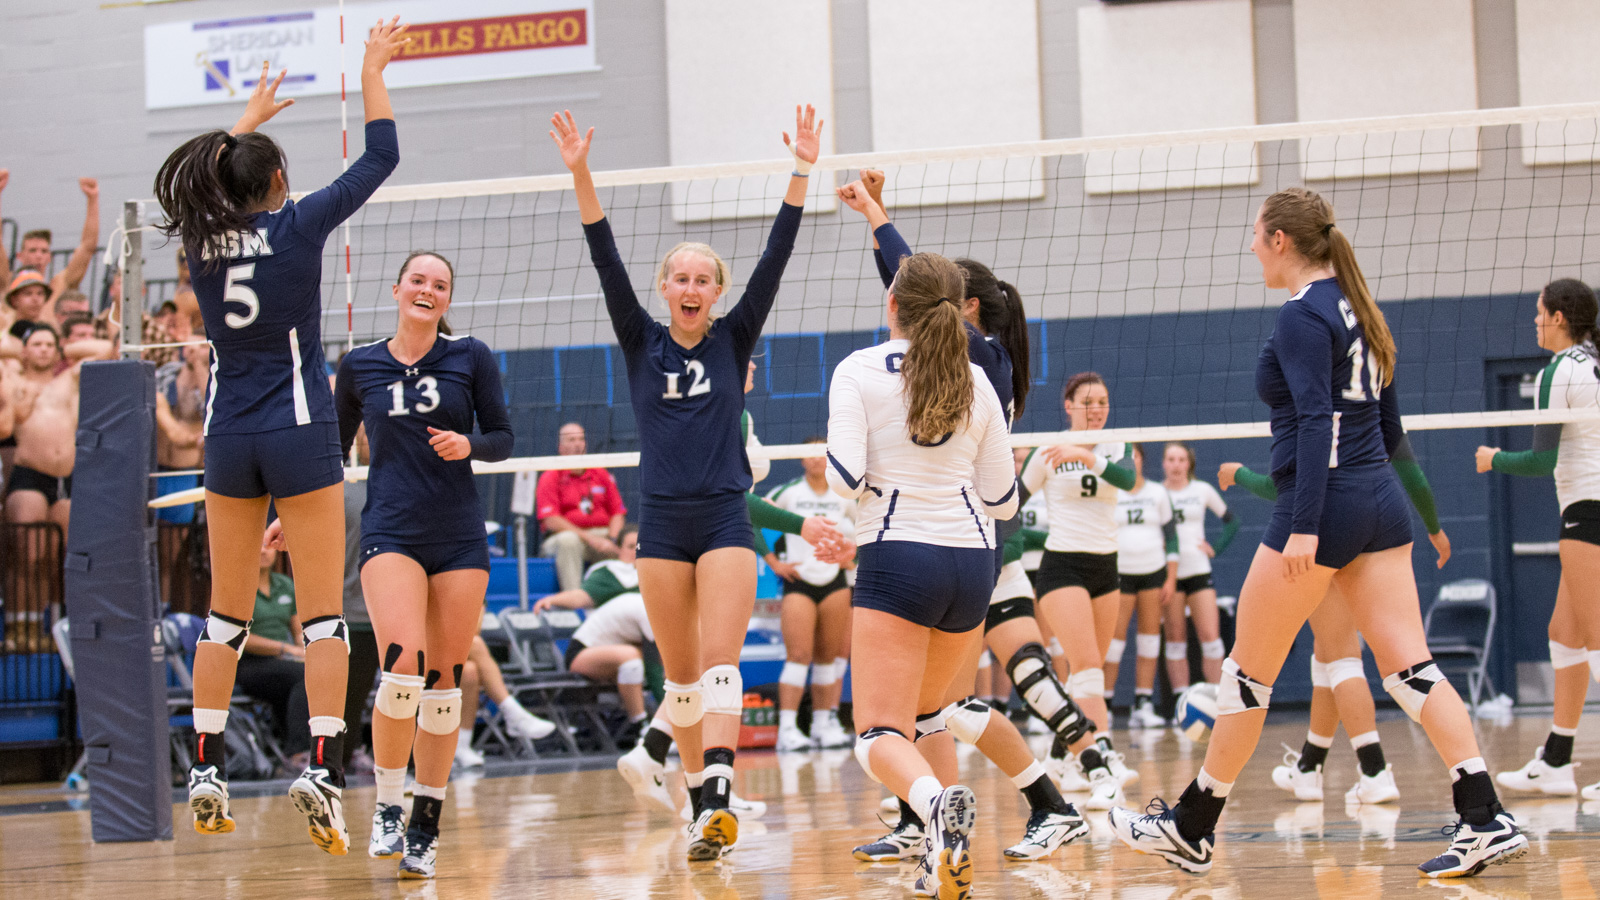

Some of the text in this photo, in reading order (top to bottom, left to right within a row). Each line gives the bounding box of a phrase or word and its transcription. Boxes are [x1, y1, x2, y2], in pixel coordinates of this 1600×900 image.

[207, 26, 314, 53] SHERIDAN
[391, 16, 580, 57] ELLS FARGO
[223, 262, 260, 329] 5
[387, 375, 441, 417] 13
[662, 359, 711, 399] 12
[1081, 474, 1098, 497] 9
[1127, 508, 1145, 525] 12
